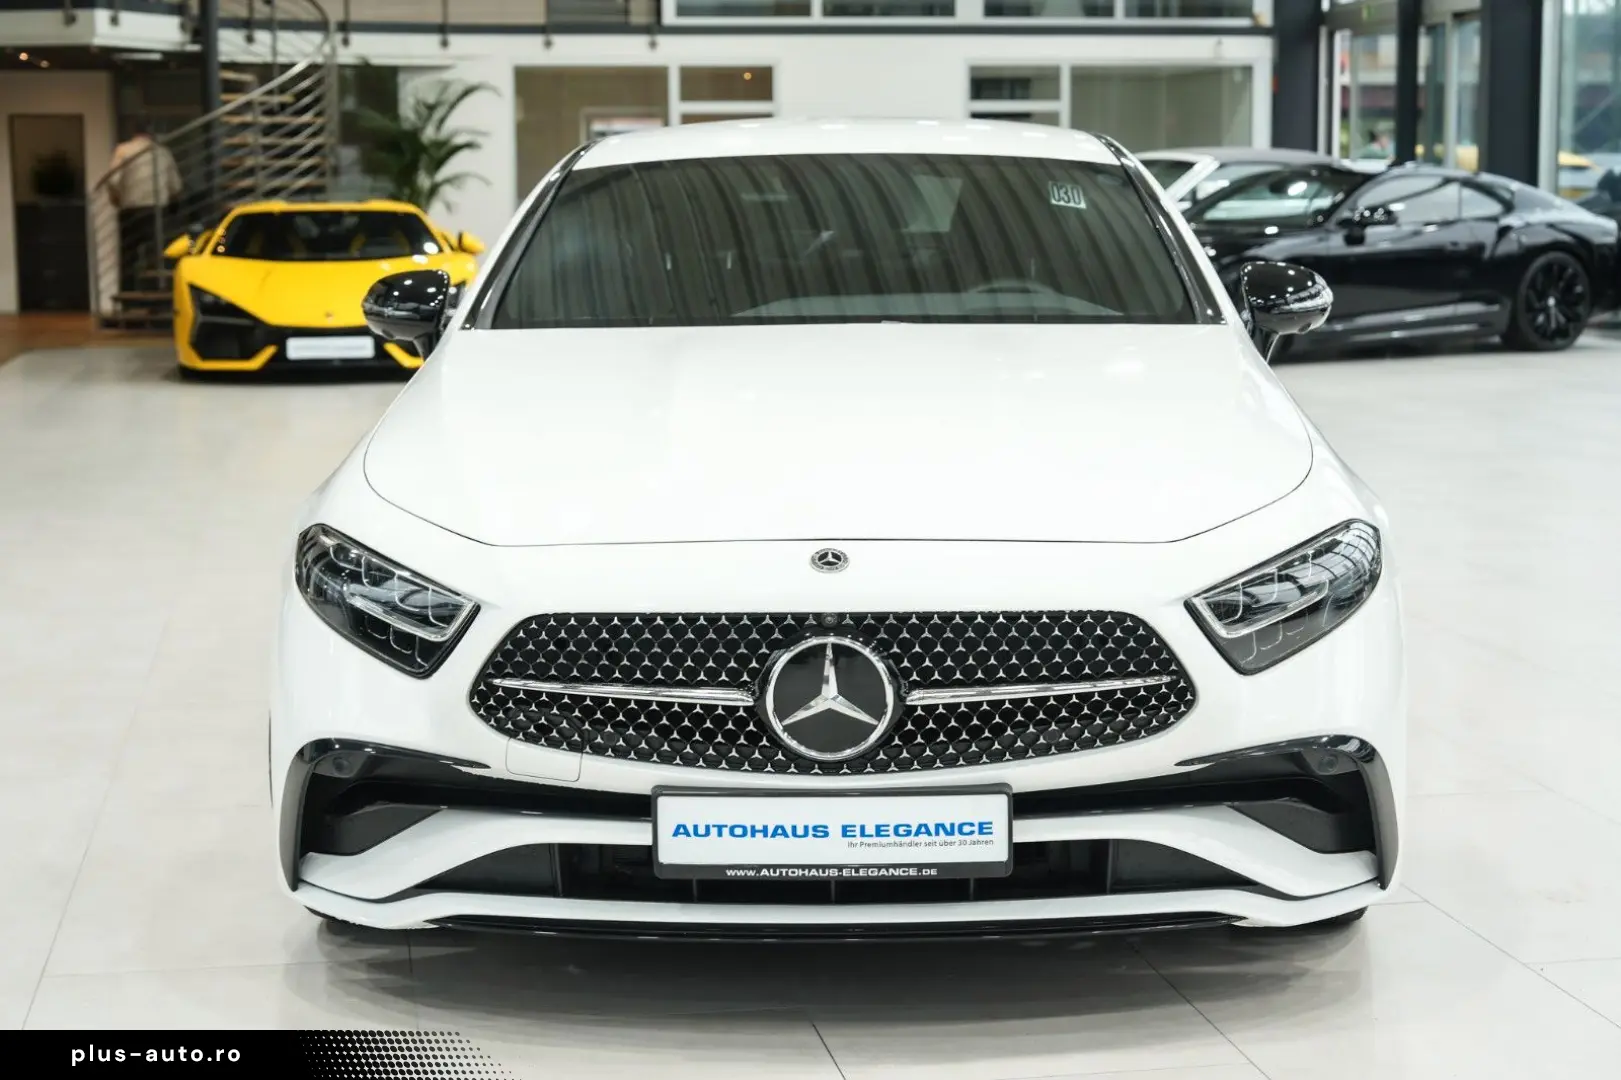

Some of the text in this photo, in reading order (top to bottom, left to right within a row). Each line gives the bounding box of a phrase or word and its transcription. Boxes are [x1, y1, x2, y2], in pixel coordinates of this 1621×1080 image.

[1051, 184, 1081, 205] 030
[672, 821, 993, 838] AUTOHAUS ELEGANCE
[860, 839, 923, 848] Premiumhändler
[924, 839, 937, 847] seit
